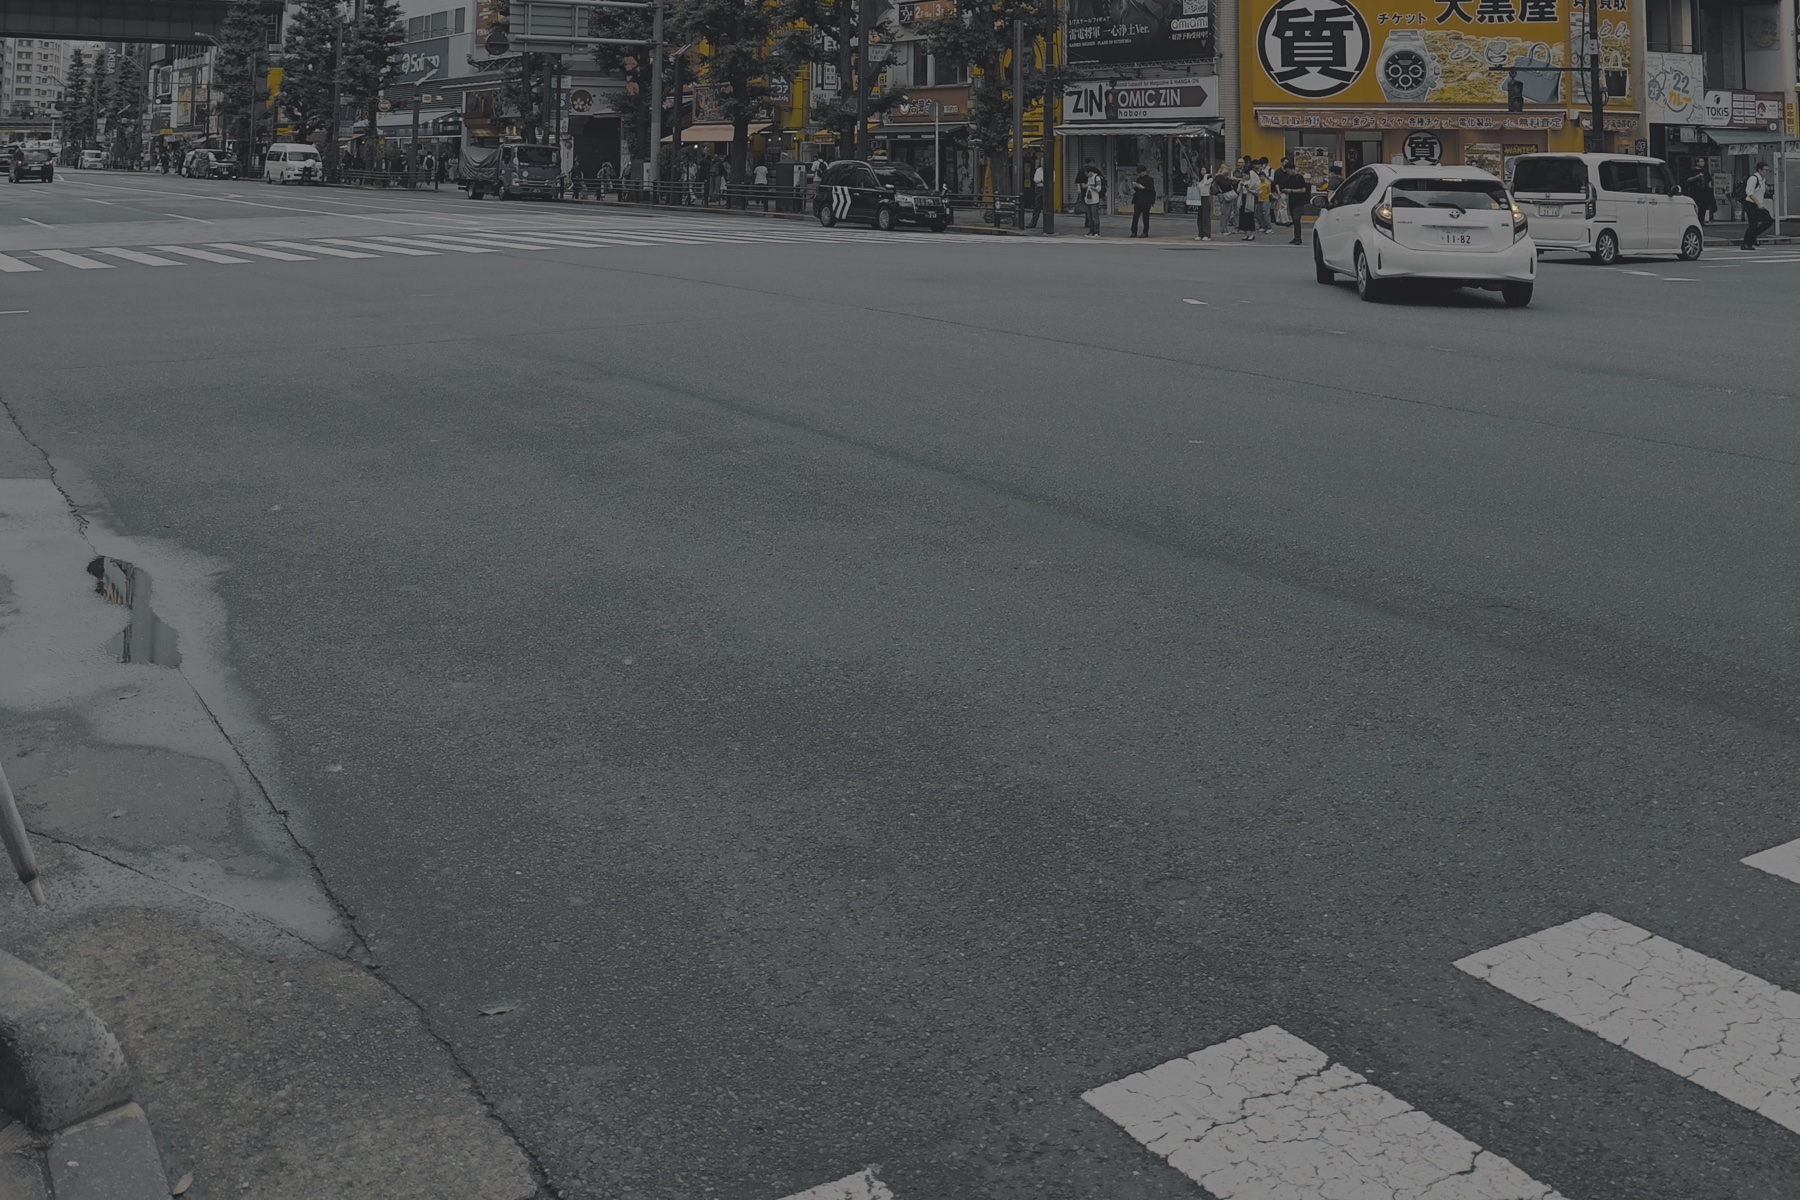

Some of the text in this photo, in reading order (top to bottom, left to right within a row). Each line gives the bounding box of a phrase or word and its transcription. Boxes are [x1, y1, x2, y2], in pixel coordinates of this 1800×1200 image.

[1171, 17, 1208, 31] amiami
[1377, 12, 1427, 25] チケット
[1270, 5, 1359, 84] 質
[107, 46, 117, 75] AKIBA
[1673, 73, 1689, 95] 22
[1118, 90, 1156, 107] OMIC
[1159, 89, 1181, 105] ZIN
[1119, 109, 1147, 117] habara
[1260, 115, 1300, 125] 高価買取
[1518, 117, 1563, 129] 無料査定
[1407, 136, 1437, 164] 質
[1505, 145, 1537, 154] WANTED
[1446, 234, 1471, 244] 11-82
